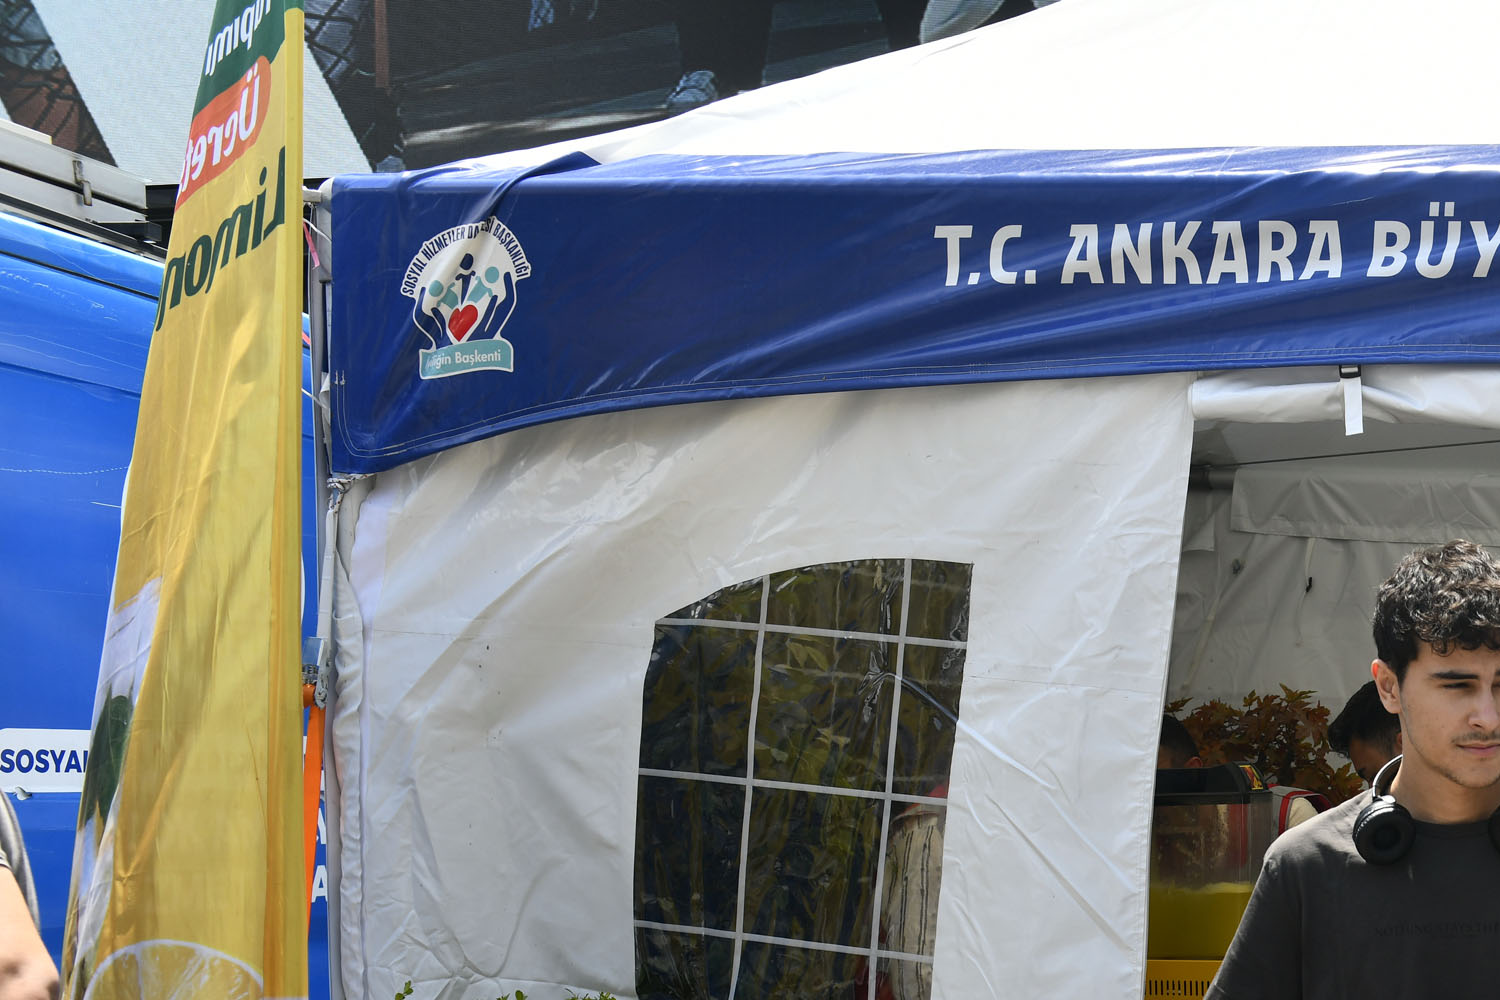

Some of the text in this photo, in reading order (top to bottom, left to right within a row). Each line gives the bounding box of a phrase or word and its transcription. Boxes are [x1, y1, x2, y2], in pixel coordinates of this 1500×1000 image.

[402, 257, 427, 296] SOSYAL
[421, 226, 465, 261] HİZMETLER
[492, 223, 530, 278] BAŞKANLIĞI
[933, 225, 1036, 286] T.C.
[1060, 220, 1344, 285] ANKARA
[455, 349, 501, 366] Başkenti
